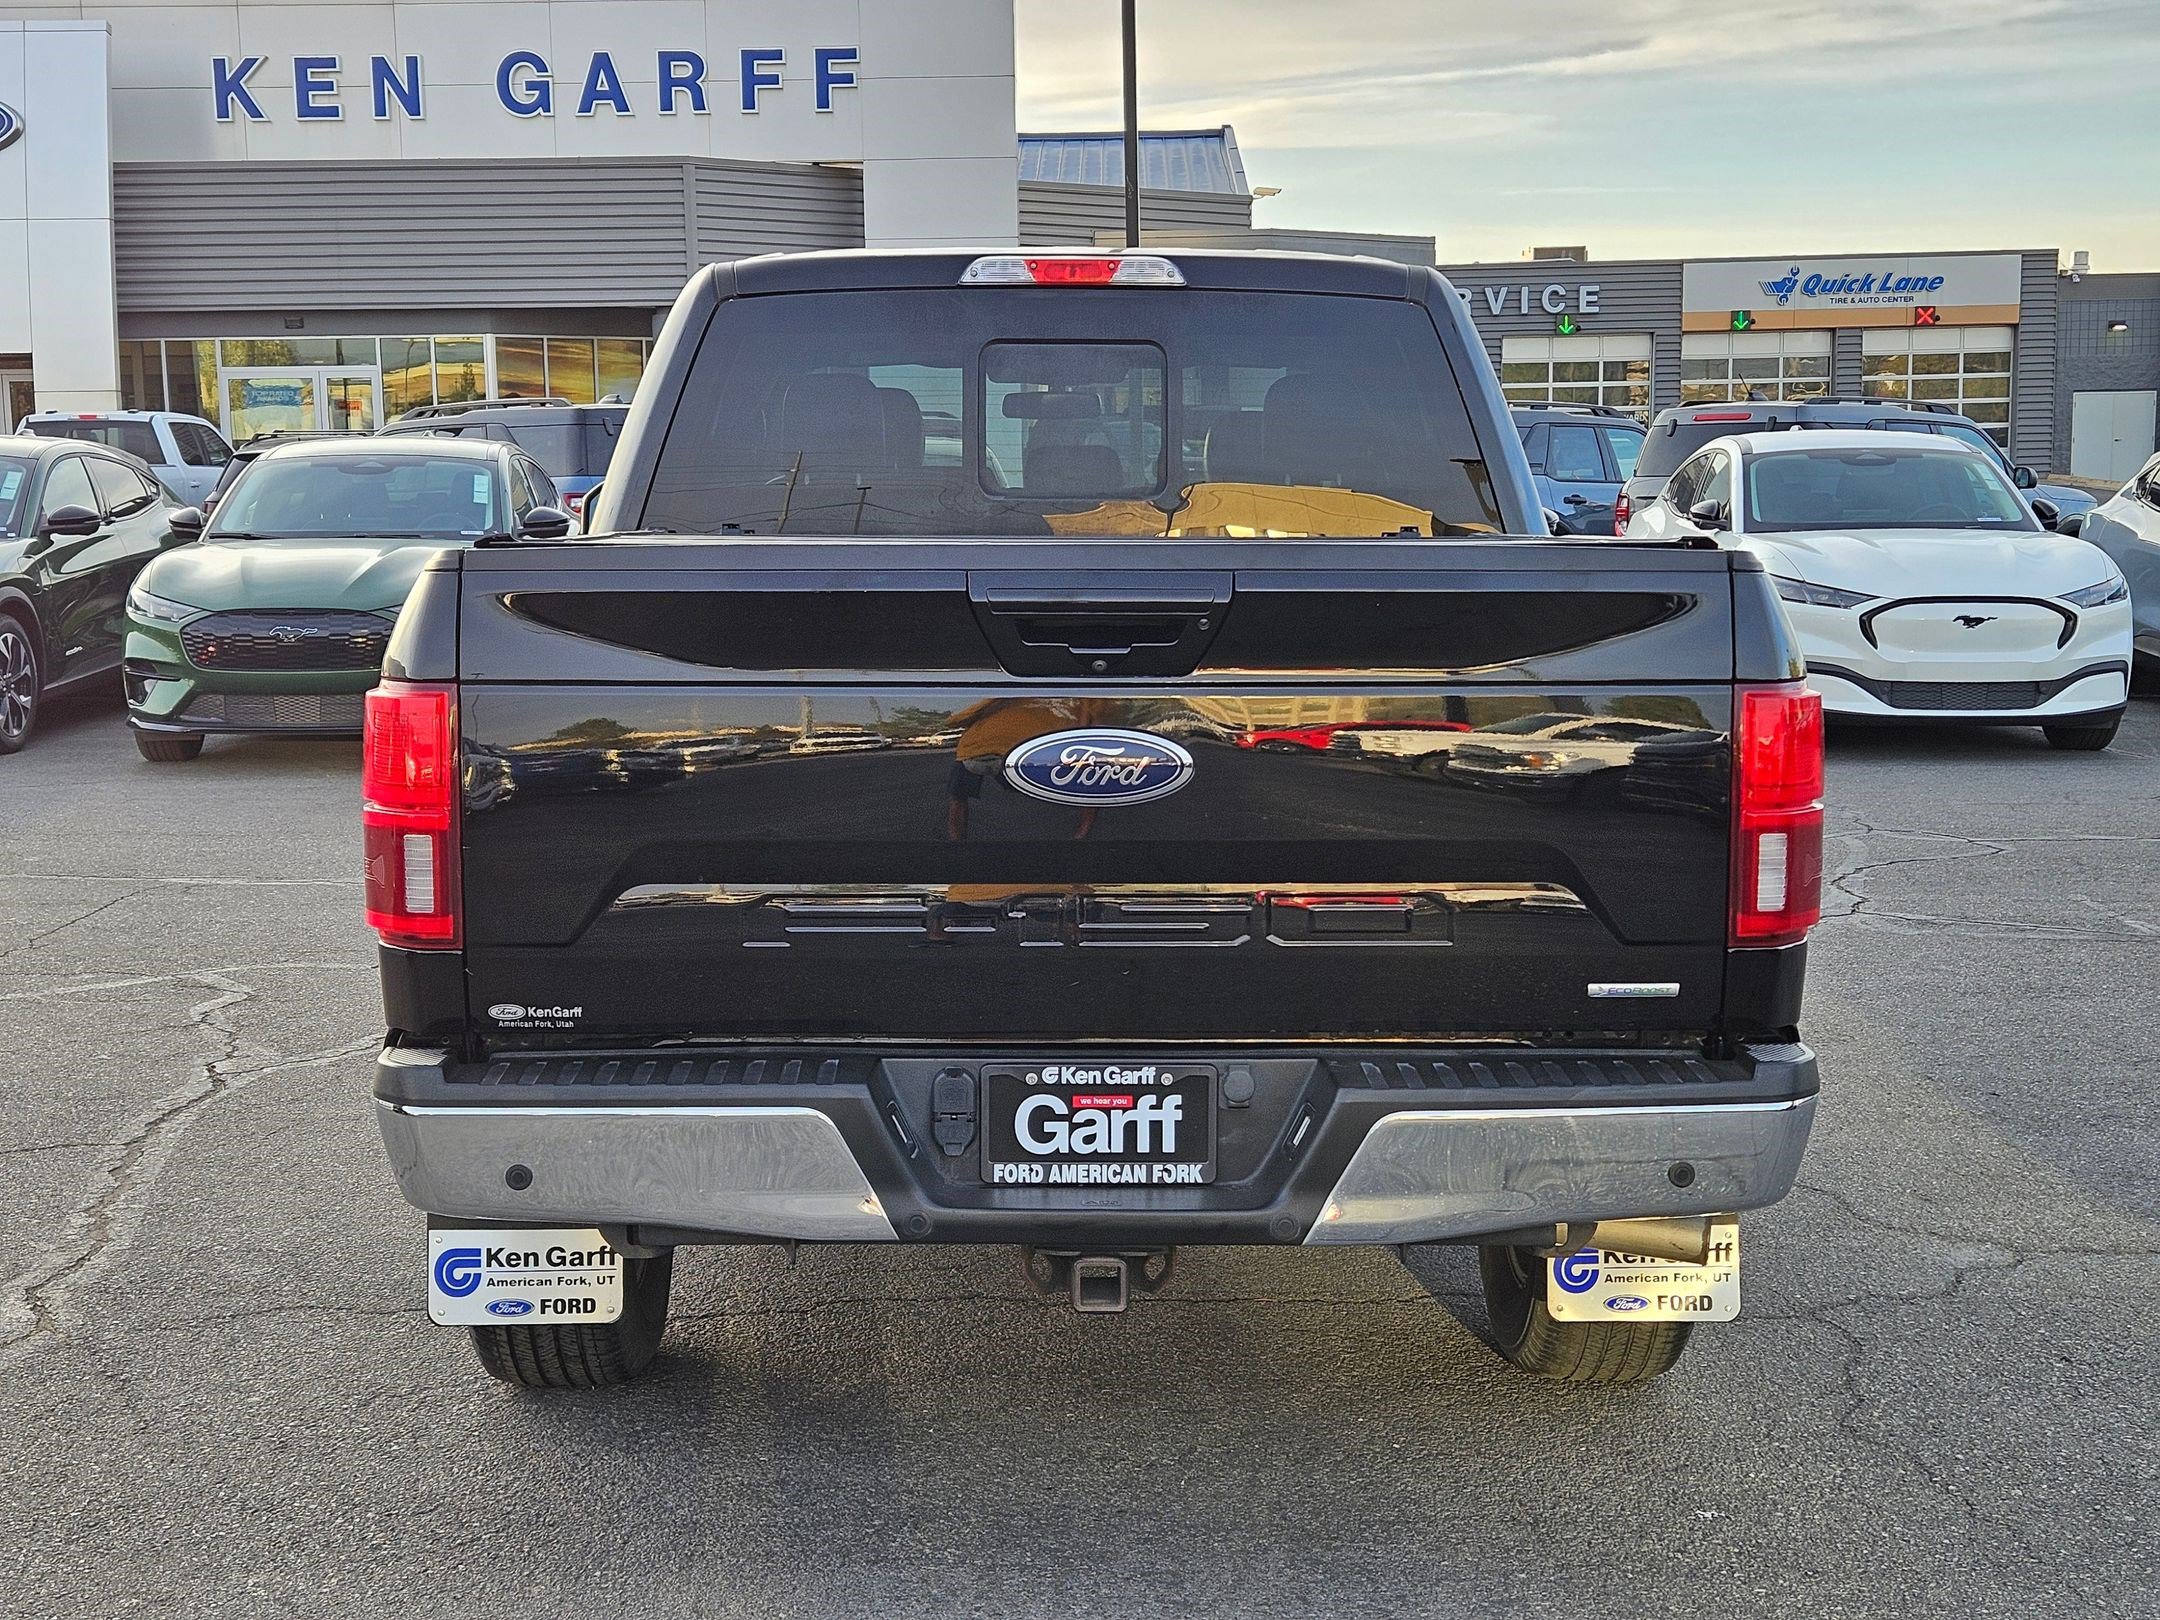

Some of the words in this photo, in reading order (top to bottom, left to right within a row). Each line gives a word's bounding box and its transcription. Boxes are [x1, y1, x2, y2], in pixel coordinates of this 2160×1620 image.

[211, 54, 426, 122] KEN
[495, 45, 862, 119] GARFF
[1801, 272, 1875, 297] Quick
[1876, 271, 1945, 293] Lane
[1882, 295, 1914, 304] CENTER
[1050, 745, 1148, 786] Ford
[498, 1020, 533, 1028] American
[535, 1020, 554, 1029] Fork,
[556, 1020, 574, 1028] Utah
[1061, 1066, 1101, 1085] Ken
[1103, 1066, 1156, 1085] Garff
[1093, 1096, 1110, 1104] hear
[1112, 1097, 1127, 1106] you
[1014, 1093, 1183, 1155] Garff
[993, 1163, 1044, 1184] FORD
[1048, 1163, 1147, 1184] AMERICAN
[1151, 1163, 1204, 1184] FORK
[485, 1247, 540, 1268] Ken
[486, 1277, 552, 1288] American
[556, 1276, 592, 1289] Fork,
[596, 1275, 616, 1286] UT
[1604, 1273, 1668, 1284] American
[1673, 1273, 1708, 1284] Fork,
[1712, 1273, 1731, 1283] UT
[495, 1301, 525, 1315] Ford
[540, 1297, 597, 1315] FORD
[1613, 1298, 1642, 1310] Ford
[1657, 1295, 1713, 1312] FORD
